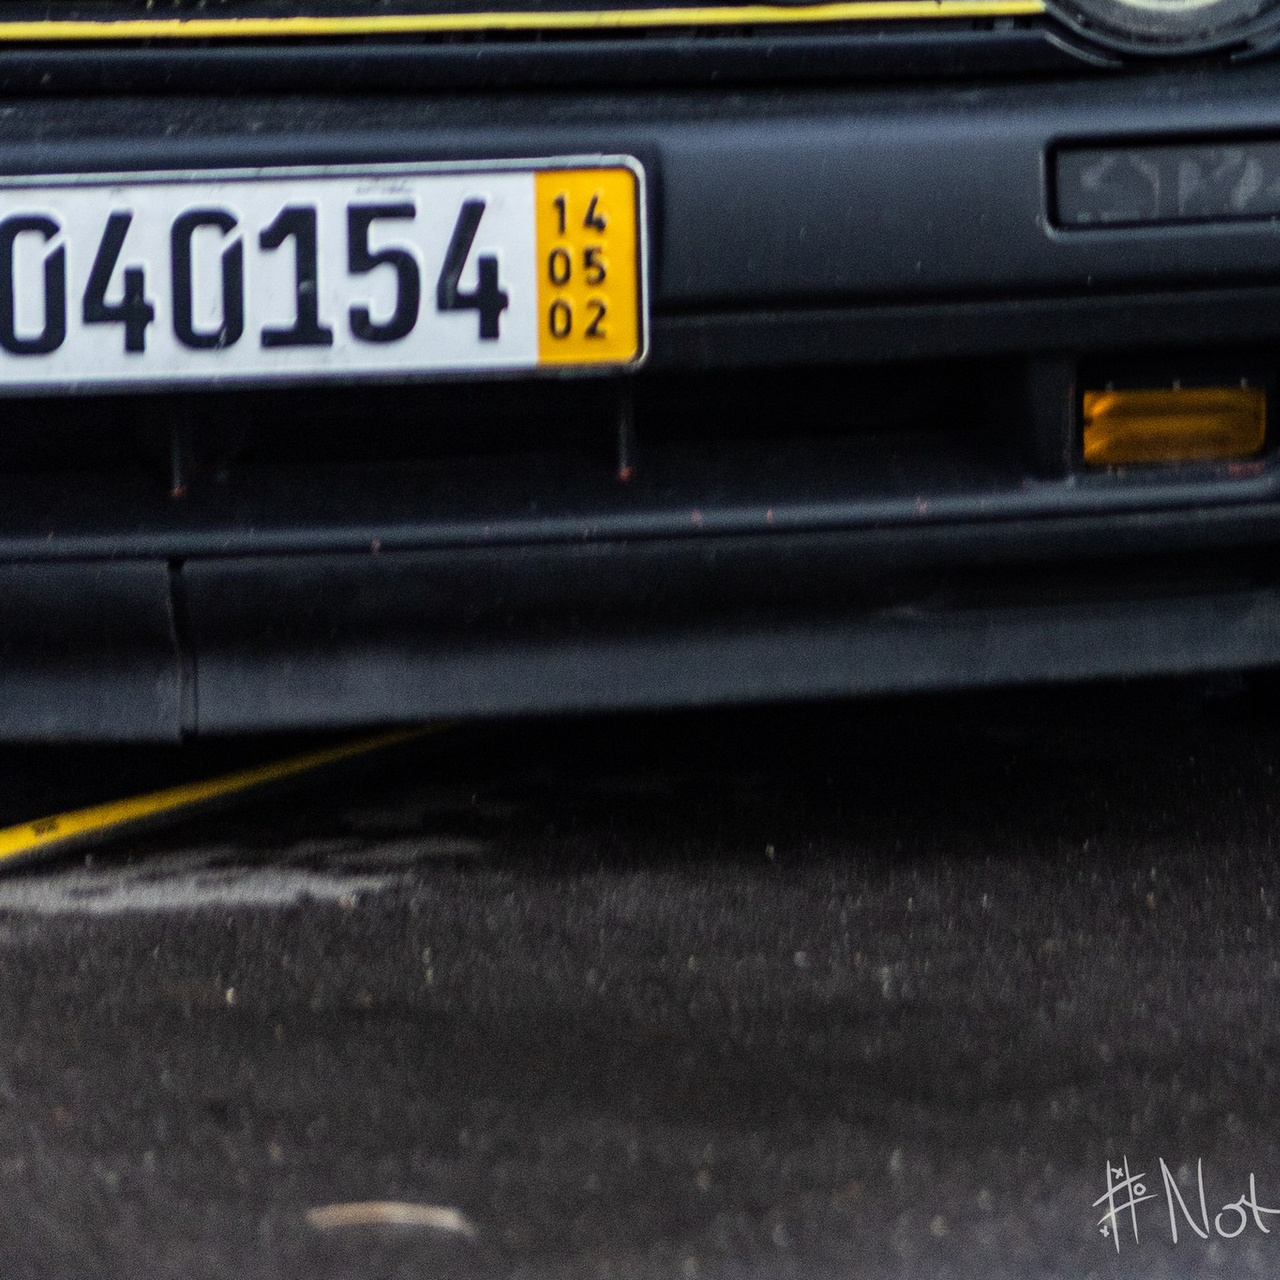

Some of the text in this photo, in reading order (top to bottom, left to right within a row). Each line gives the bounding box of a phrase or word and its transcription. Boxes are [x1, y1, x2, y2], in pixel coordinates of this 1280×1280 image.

[0, 198, 509, 355] 040154
[548, 246, 607, 287] 05
[548, 298, 607, 340] 02
